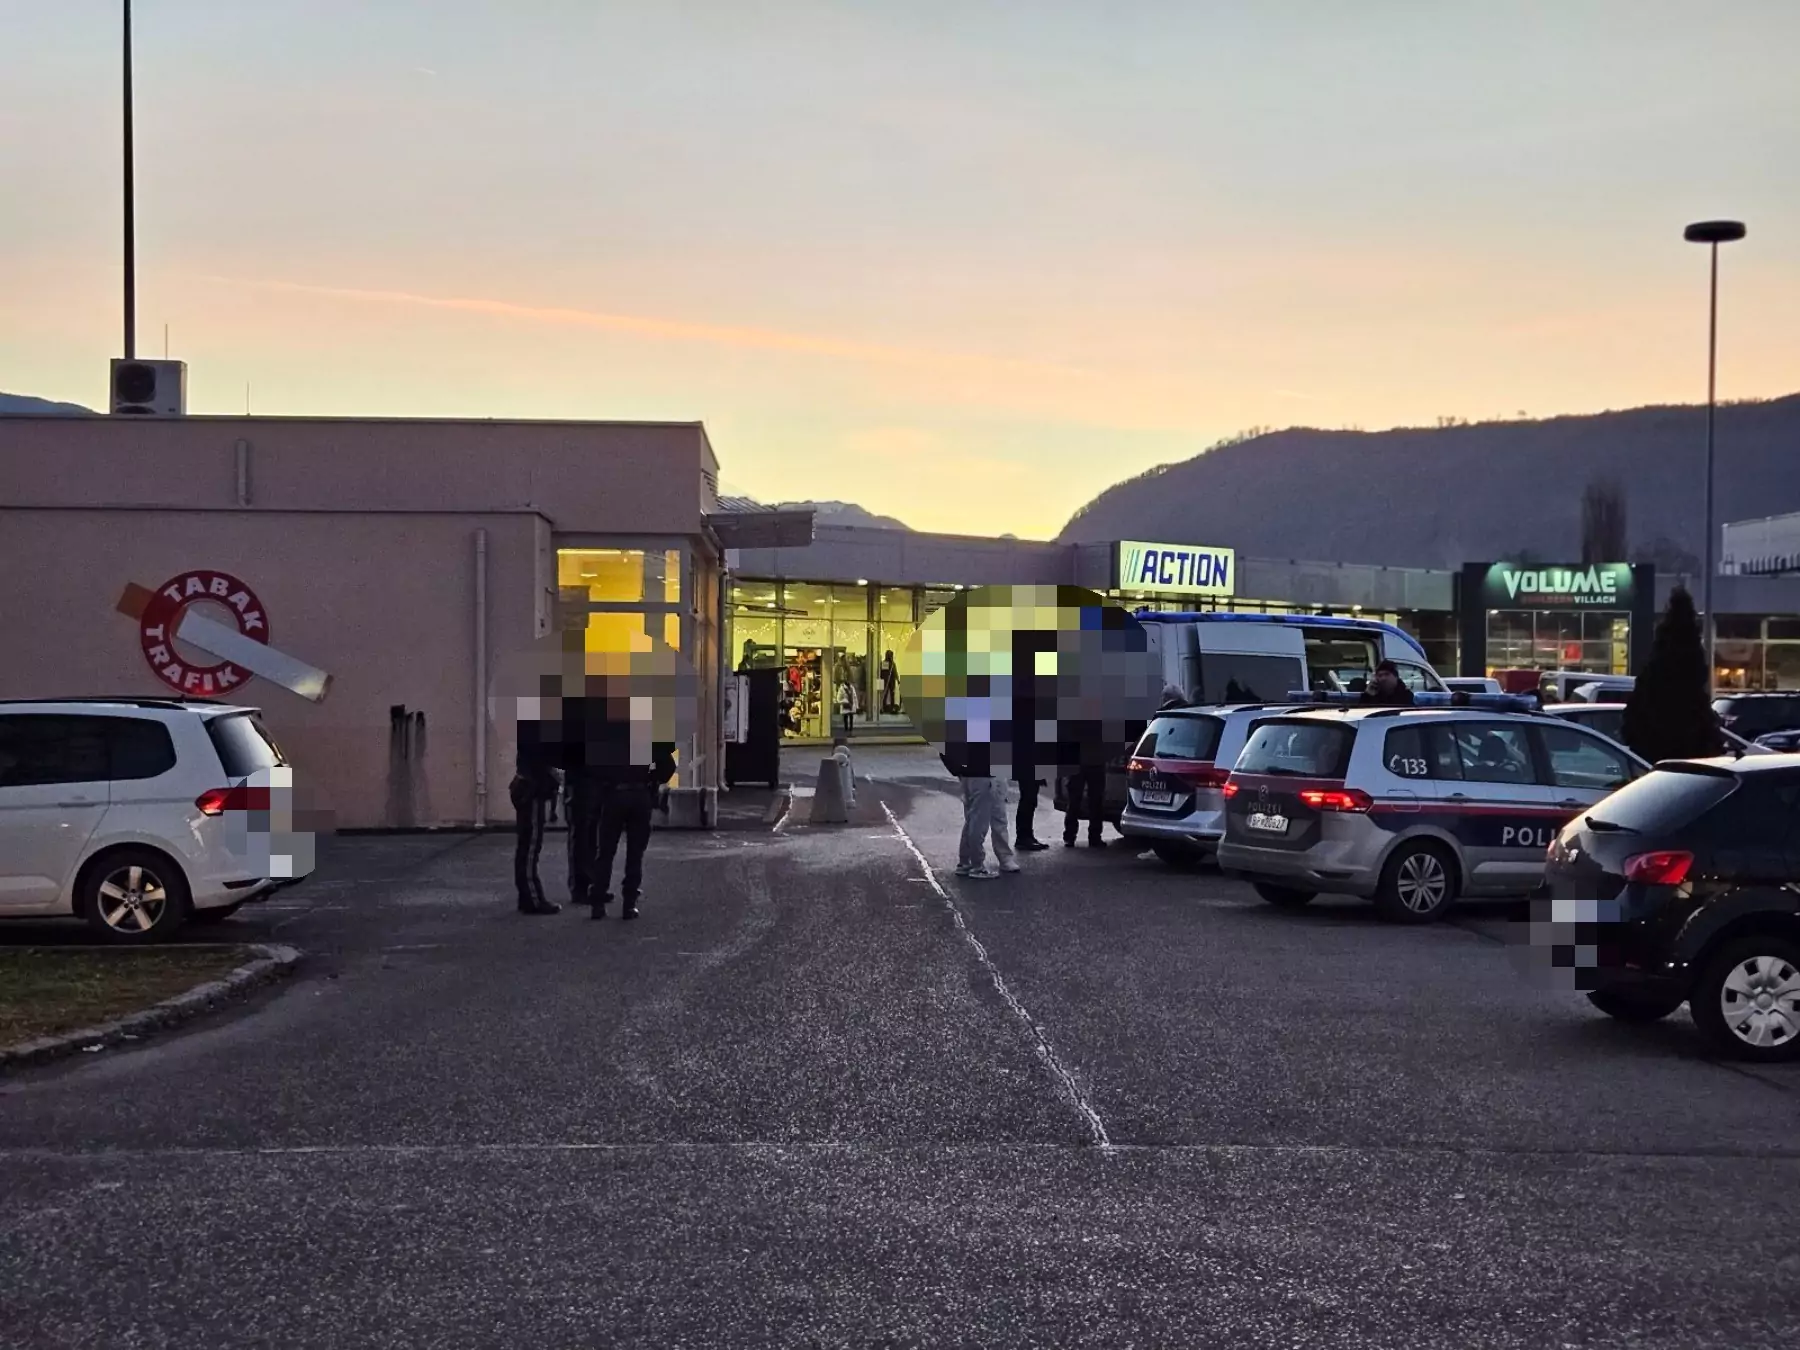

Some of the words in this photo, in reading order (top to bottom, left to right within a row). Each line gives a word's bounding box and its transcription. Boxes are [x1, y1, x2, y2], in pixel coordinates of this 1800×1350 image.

[1140, 550, 1229, 587] ACTION
[1502, 564, 1617, 600] VOLUME
[163, 577, 263, 631] TABAK
[1574, 595, 1617, 604] VILLACH
[145, 623, 240, 691] TRAFIK
[1401, 757, 1428, 775] 133
[1141, 780, 1167, 790] POLIZEI
[1247, 801, 1282, 814] POLIZEI
